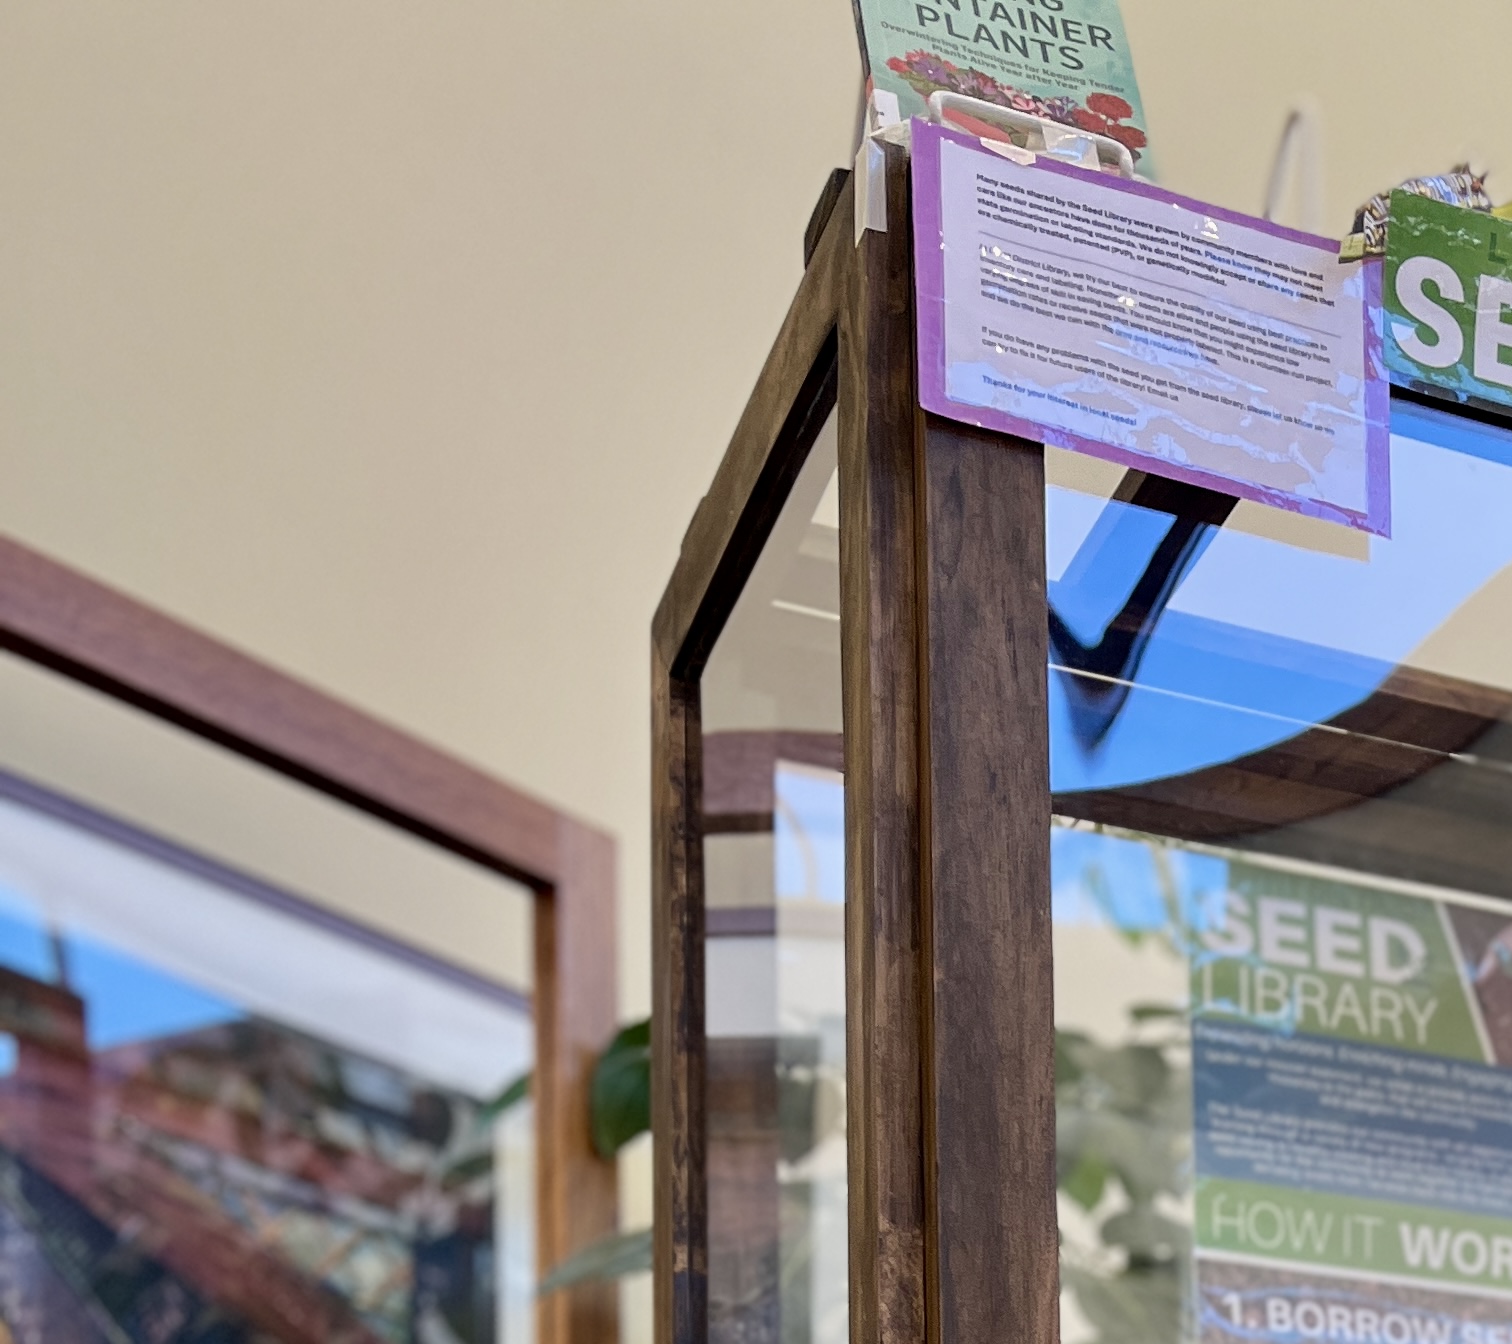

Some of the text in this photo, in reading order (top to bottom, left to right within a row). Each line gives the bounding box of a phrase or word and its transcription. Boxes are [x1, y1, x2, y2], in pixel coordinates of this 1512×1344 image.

[880, 20, 1125, 94] Overwintering Techniques for Keeping Tender
[915, 3, 1084, 71] PLANTS
[932, 43, 1079, 92] Plants Alive Year after Year
[982, 374, 1013, 390] Thanks
[1014, 384, 1026, 394] for
[1027, 388, 1046, 400] your
[1199, 888, 1429, 984] SEED
[1200, 962, 1438, 1045] LIBRARY
[1210, 1190, 1334, 1257] HOW
[1342, 1216, 1382, 1258] IT
[1224, 1293, 1258, 1328] 1.
